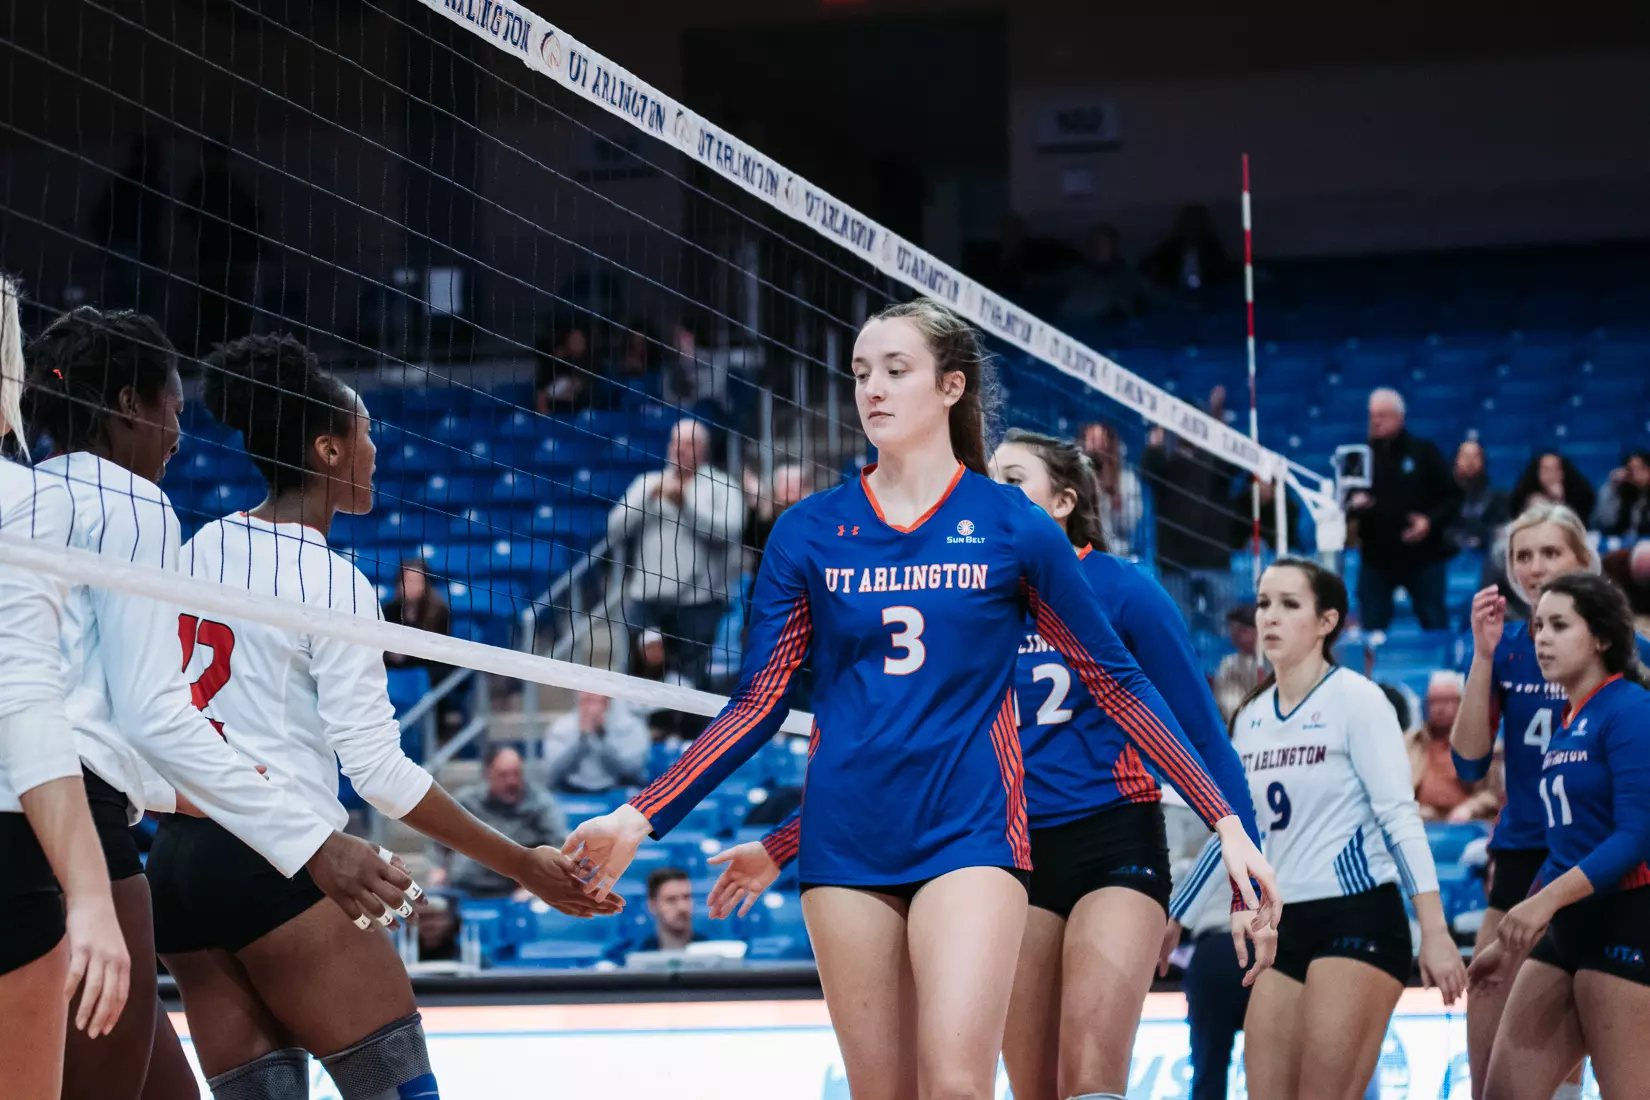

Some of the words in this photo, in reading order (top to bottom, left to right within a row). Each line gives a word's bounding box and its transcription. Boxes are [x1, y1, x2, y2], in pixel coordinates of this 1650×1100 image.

[569, 50, 588, 88] UT
[698, 128, 715, 161] UT
[824, 567, 855, 594] UT
[858, 563, 989, 593] ARLINGTON
[881, 605, 927, 676] 3
[1014, 663, 1073, 727] 2
[1524, 707, 1553, 756] 4
[1254, 745, 1327, 772] ARLINGTON
[1267, 781, 1292, 832] 9
[1539, 774, 1573, 829] 11
